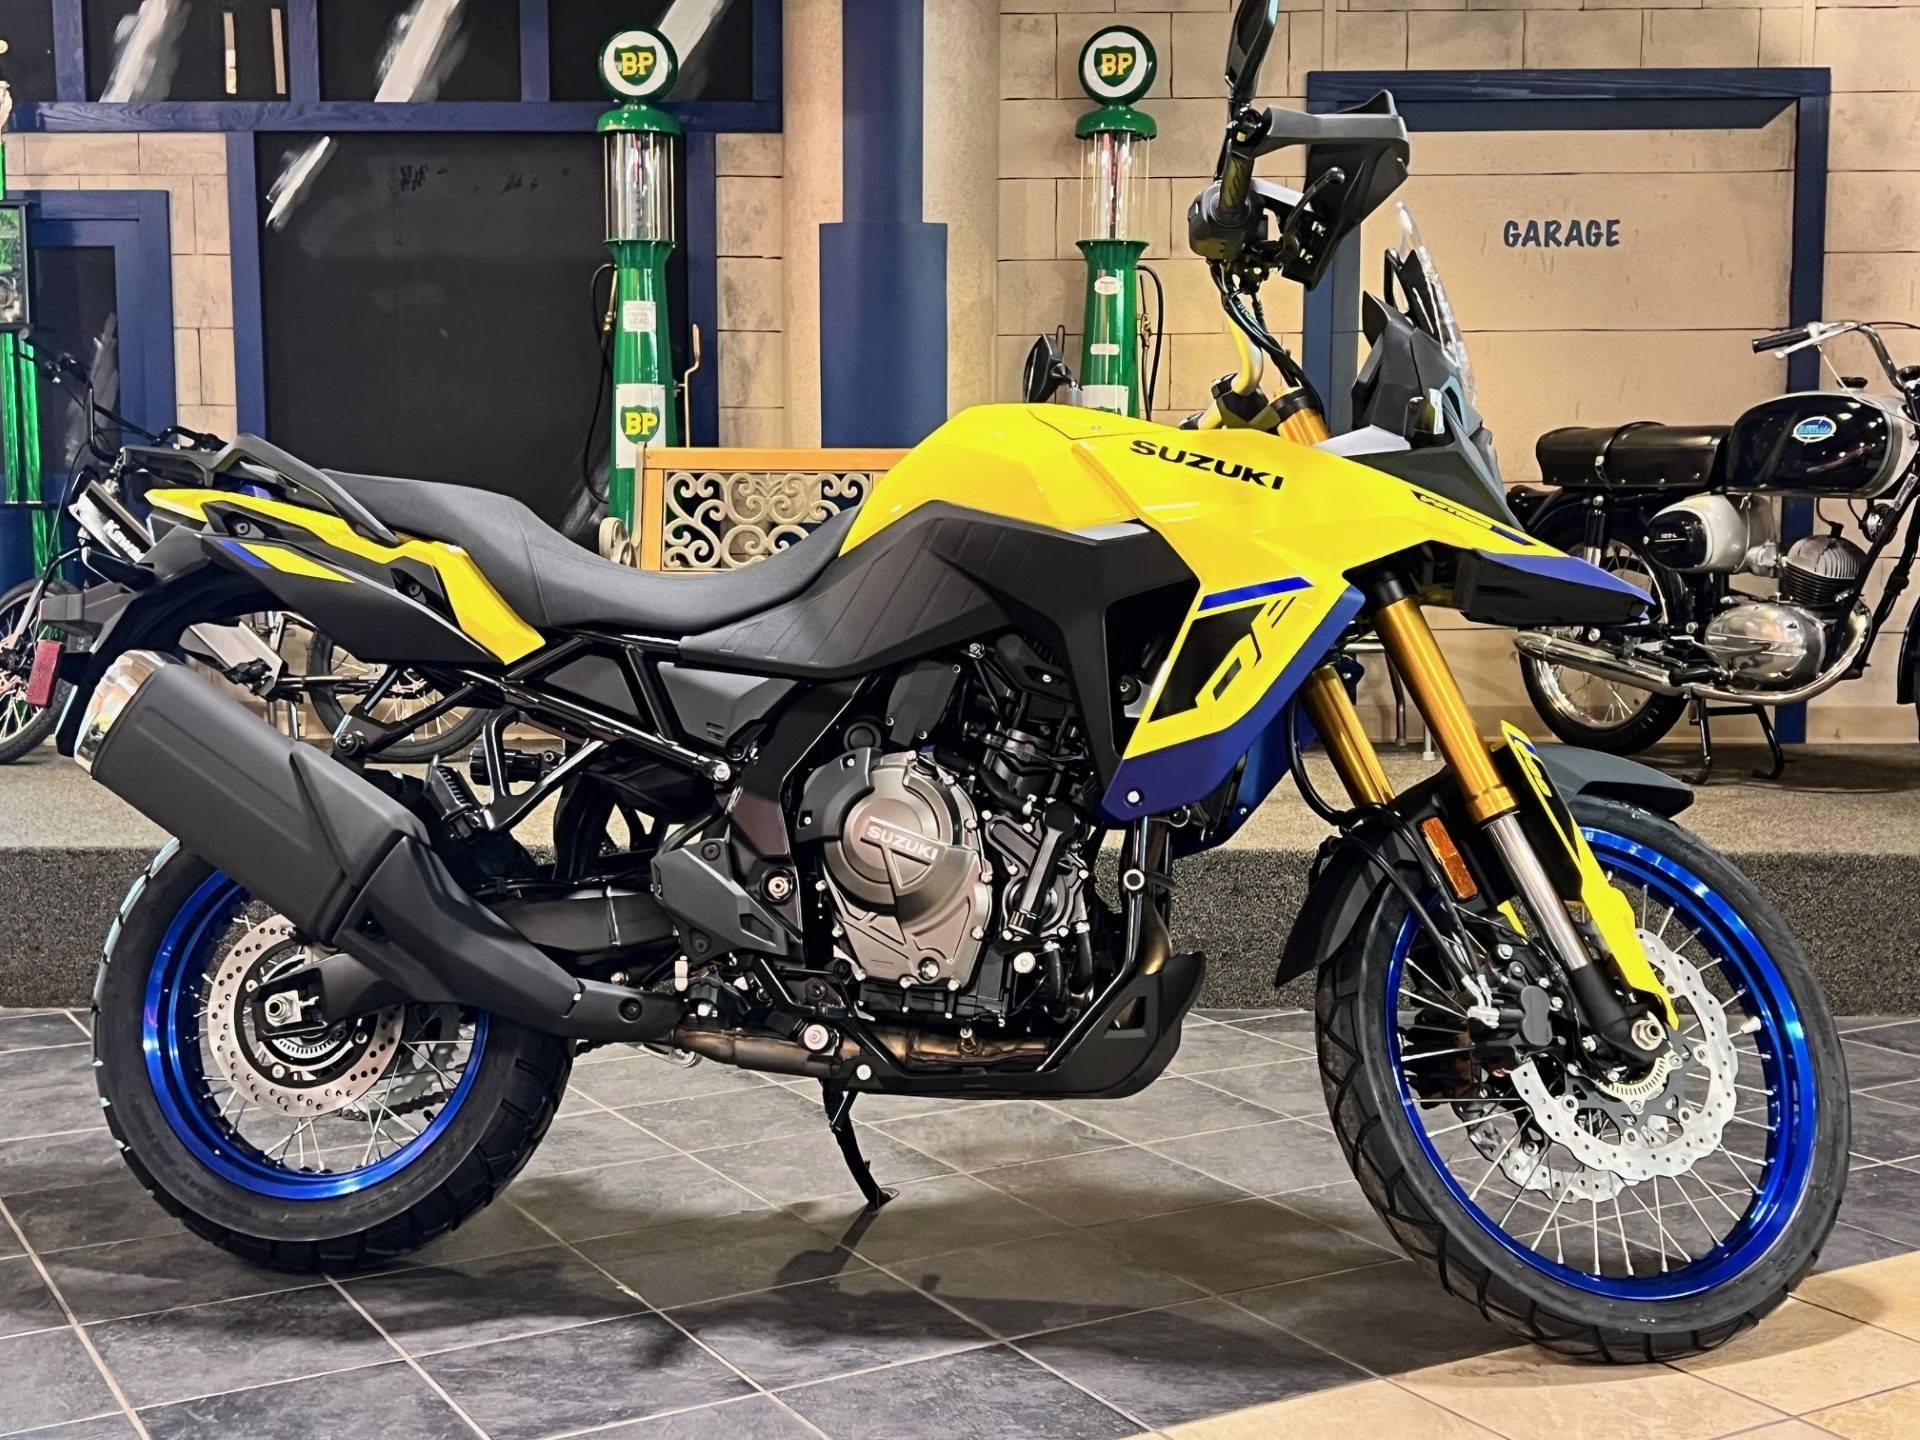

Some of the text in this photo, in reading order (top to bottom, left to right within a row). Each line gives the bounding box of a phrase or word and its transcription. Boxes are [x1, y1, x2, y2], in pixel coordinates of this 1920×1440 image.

[621, 52, 654, 75] BP
[1101, 53, 1133, 76] BP
[1503, 219, 1620, 247] GARAGE
[624, 412, 658, 435] BP
[1129, 440, 1284, 490] SUZUKI
[866, 825, 939, 861] SUZUKI
